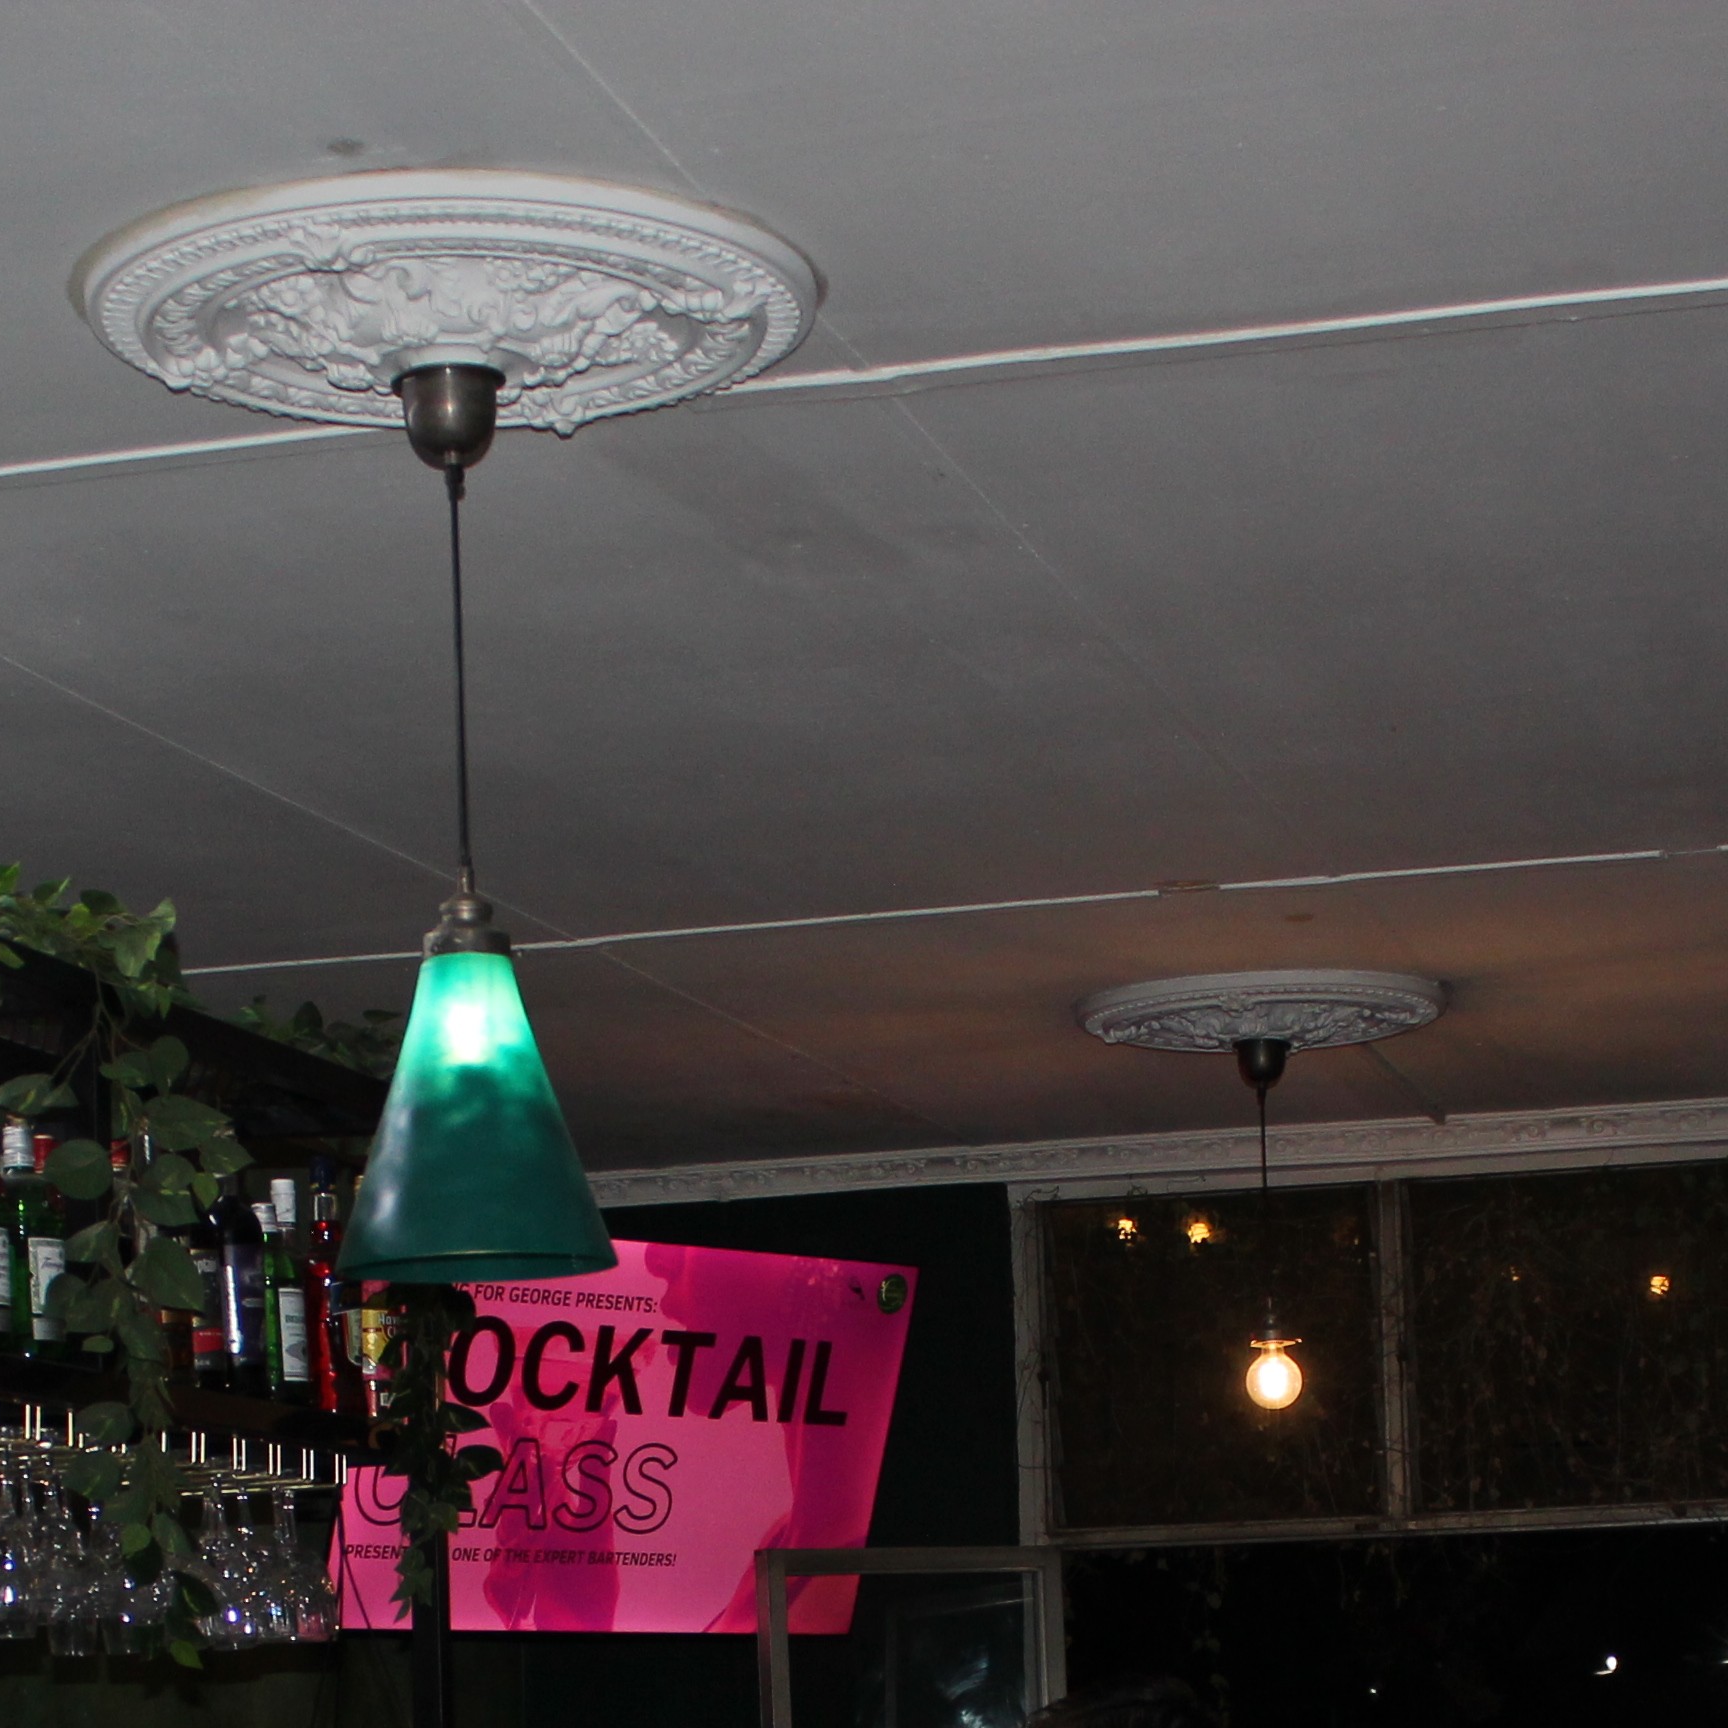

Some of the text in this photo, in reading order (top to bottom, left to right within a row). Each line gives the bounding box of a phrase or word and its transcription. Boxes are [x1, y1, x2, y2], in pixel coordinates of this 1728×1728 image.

[474, 1283, 505, 1301] FOR
[509, 1287, 572, 1307] GEORGE
[575, 1292, 658, 1313] PRESENTS:
[449, 1315, 848, 1427] OCKTAIL
[452, 1547, 480, 1562] ONE
[483, 1548, 502, 1562] OF
[505, 1549, 531, 1564] THE
[533, 1550, 585, 1565] EXPERT
[587, 1551, 677, 1567] BARTENDERS!
